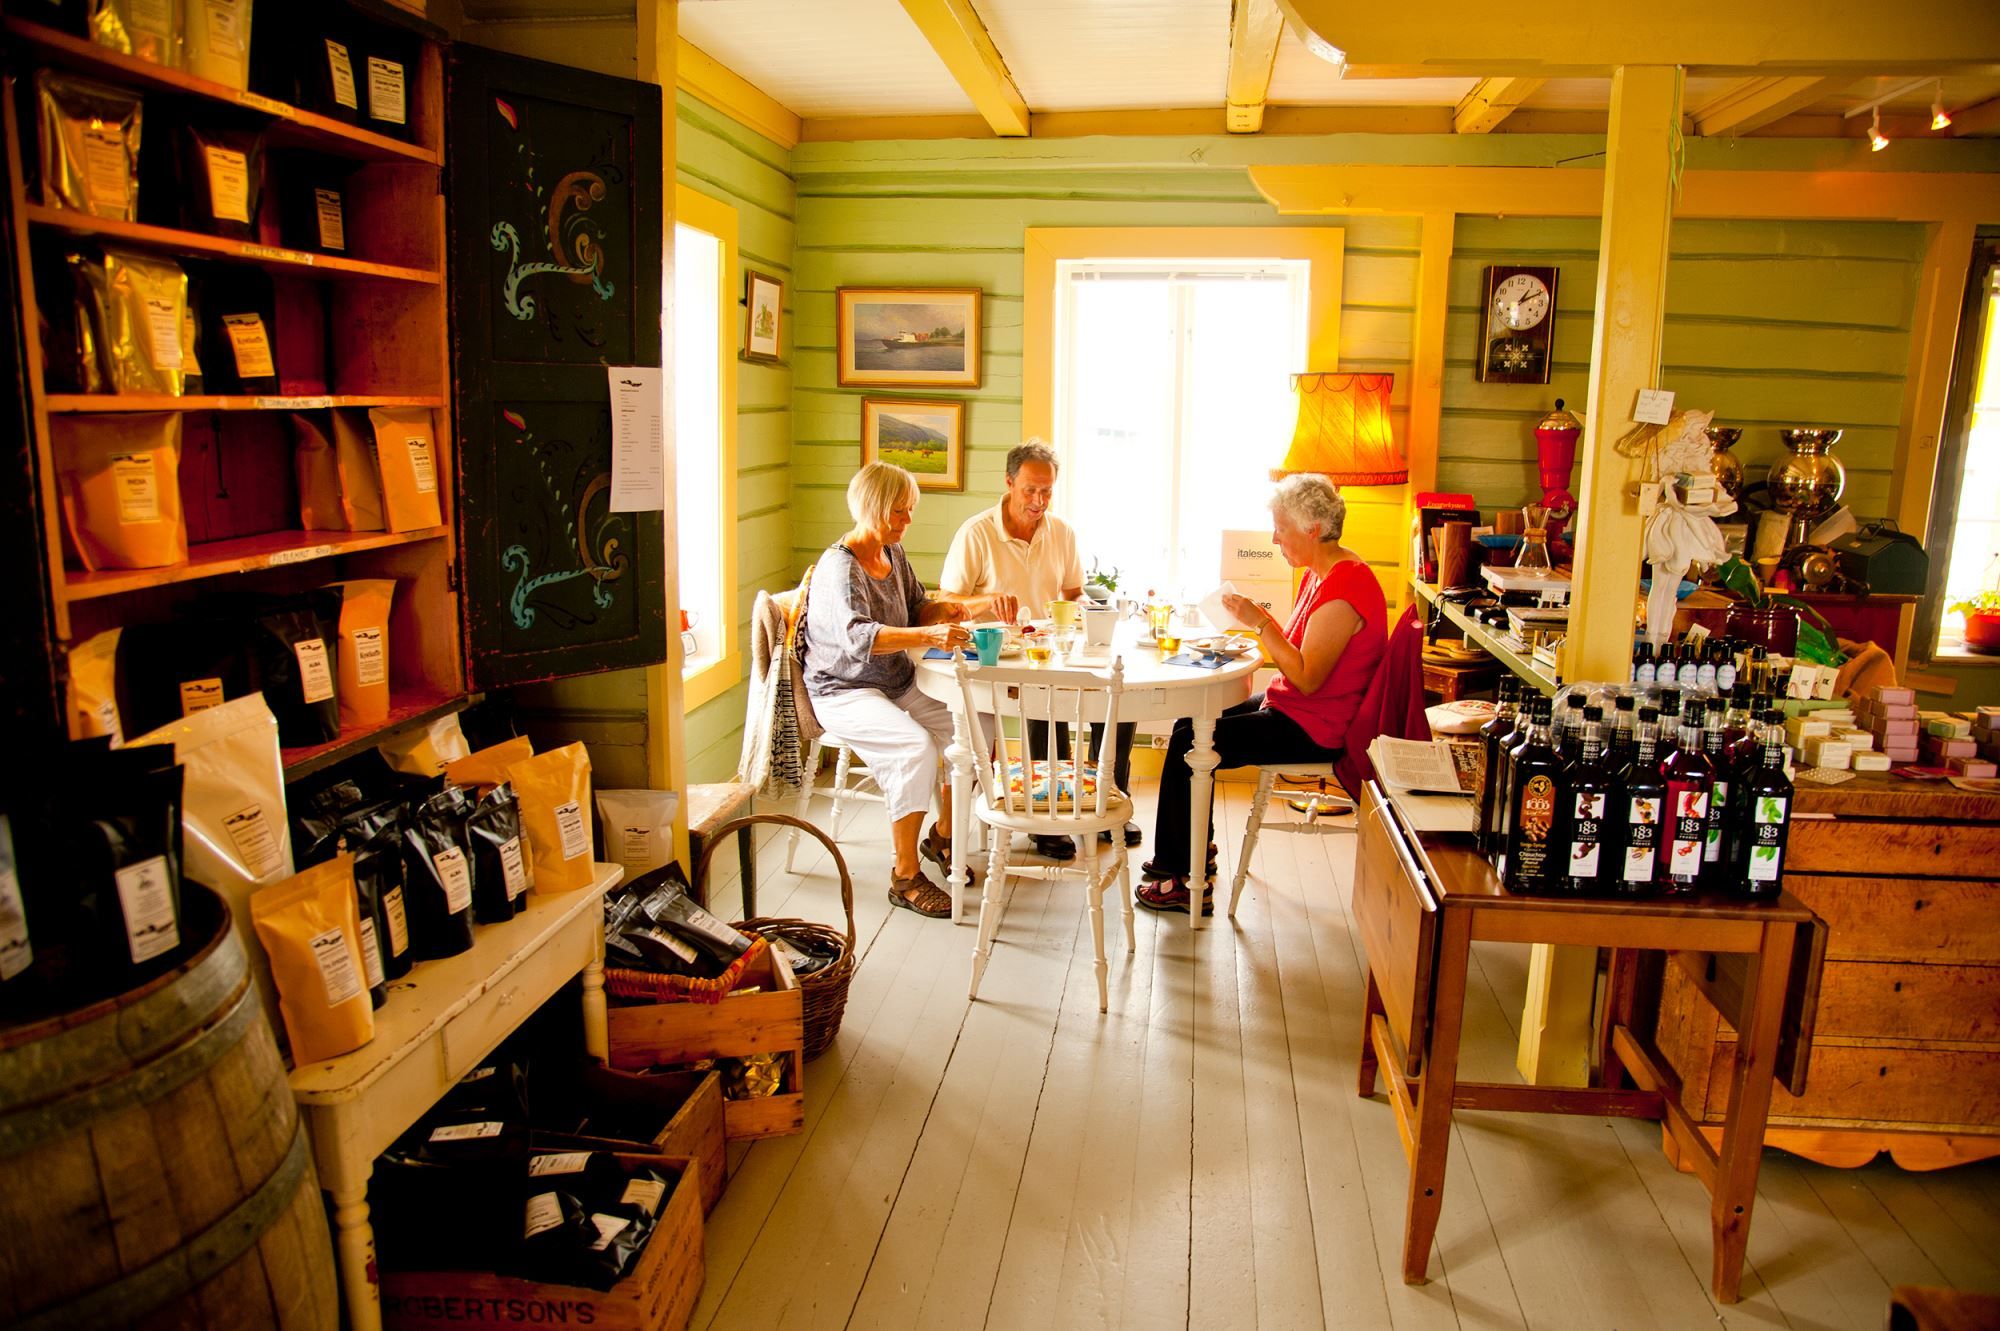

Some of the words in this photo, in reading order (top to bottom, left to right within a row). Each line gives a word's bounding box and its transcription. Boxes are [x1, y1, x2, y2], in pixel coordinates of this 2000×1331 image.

[1237, 548, 1273, 558] italesse
[1578, 820, 1597, 834] 1883
[1633, 825, 1653, 839] 1883
[1681, 819, 1700, 833] 1883
[1759, 824, 1778, 839] 1883
[385, 1296, 595, 1324] ROBERTSON'S
